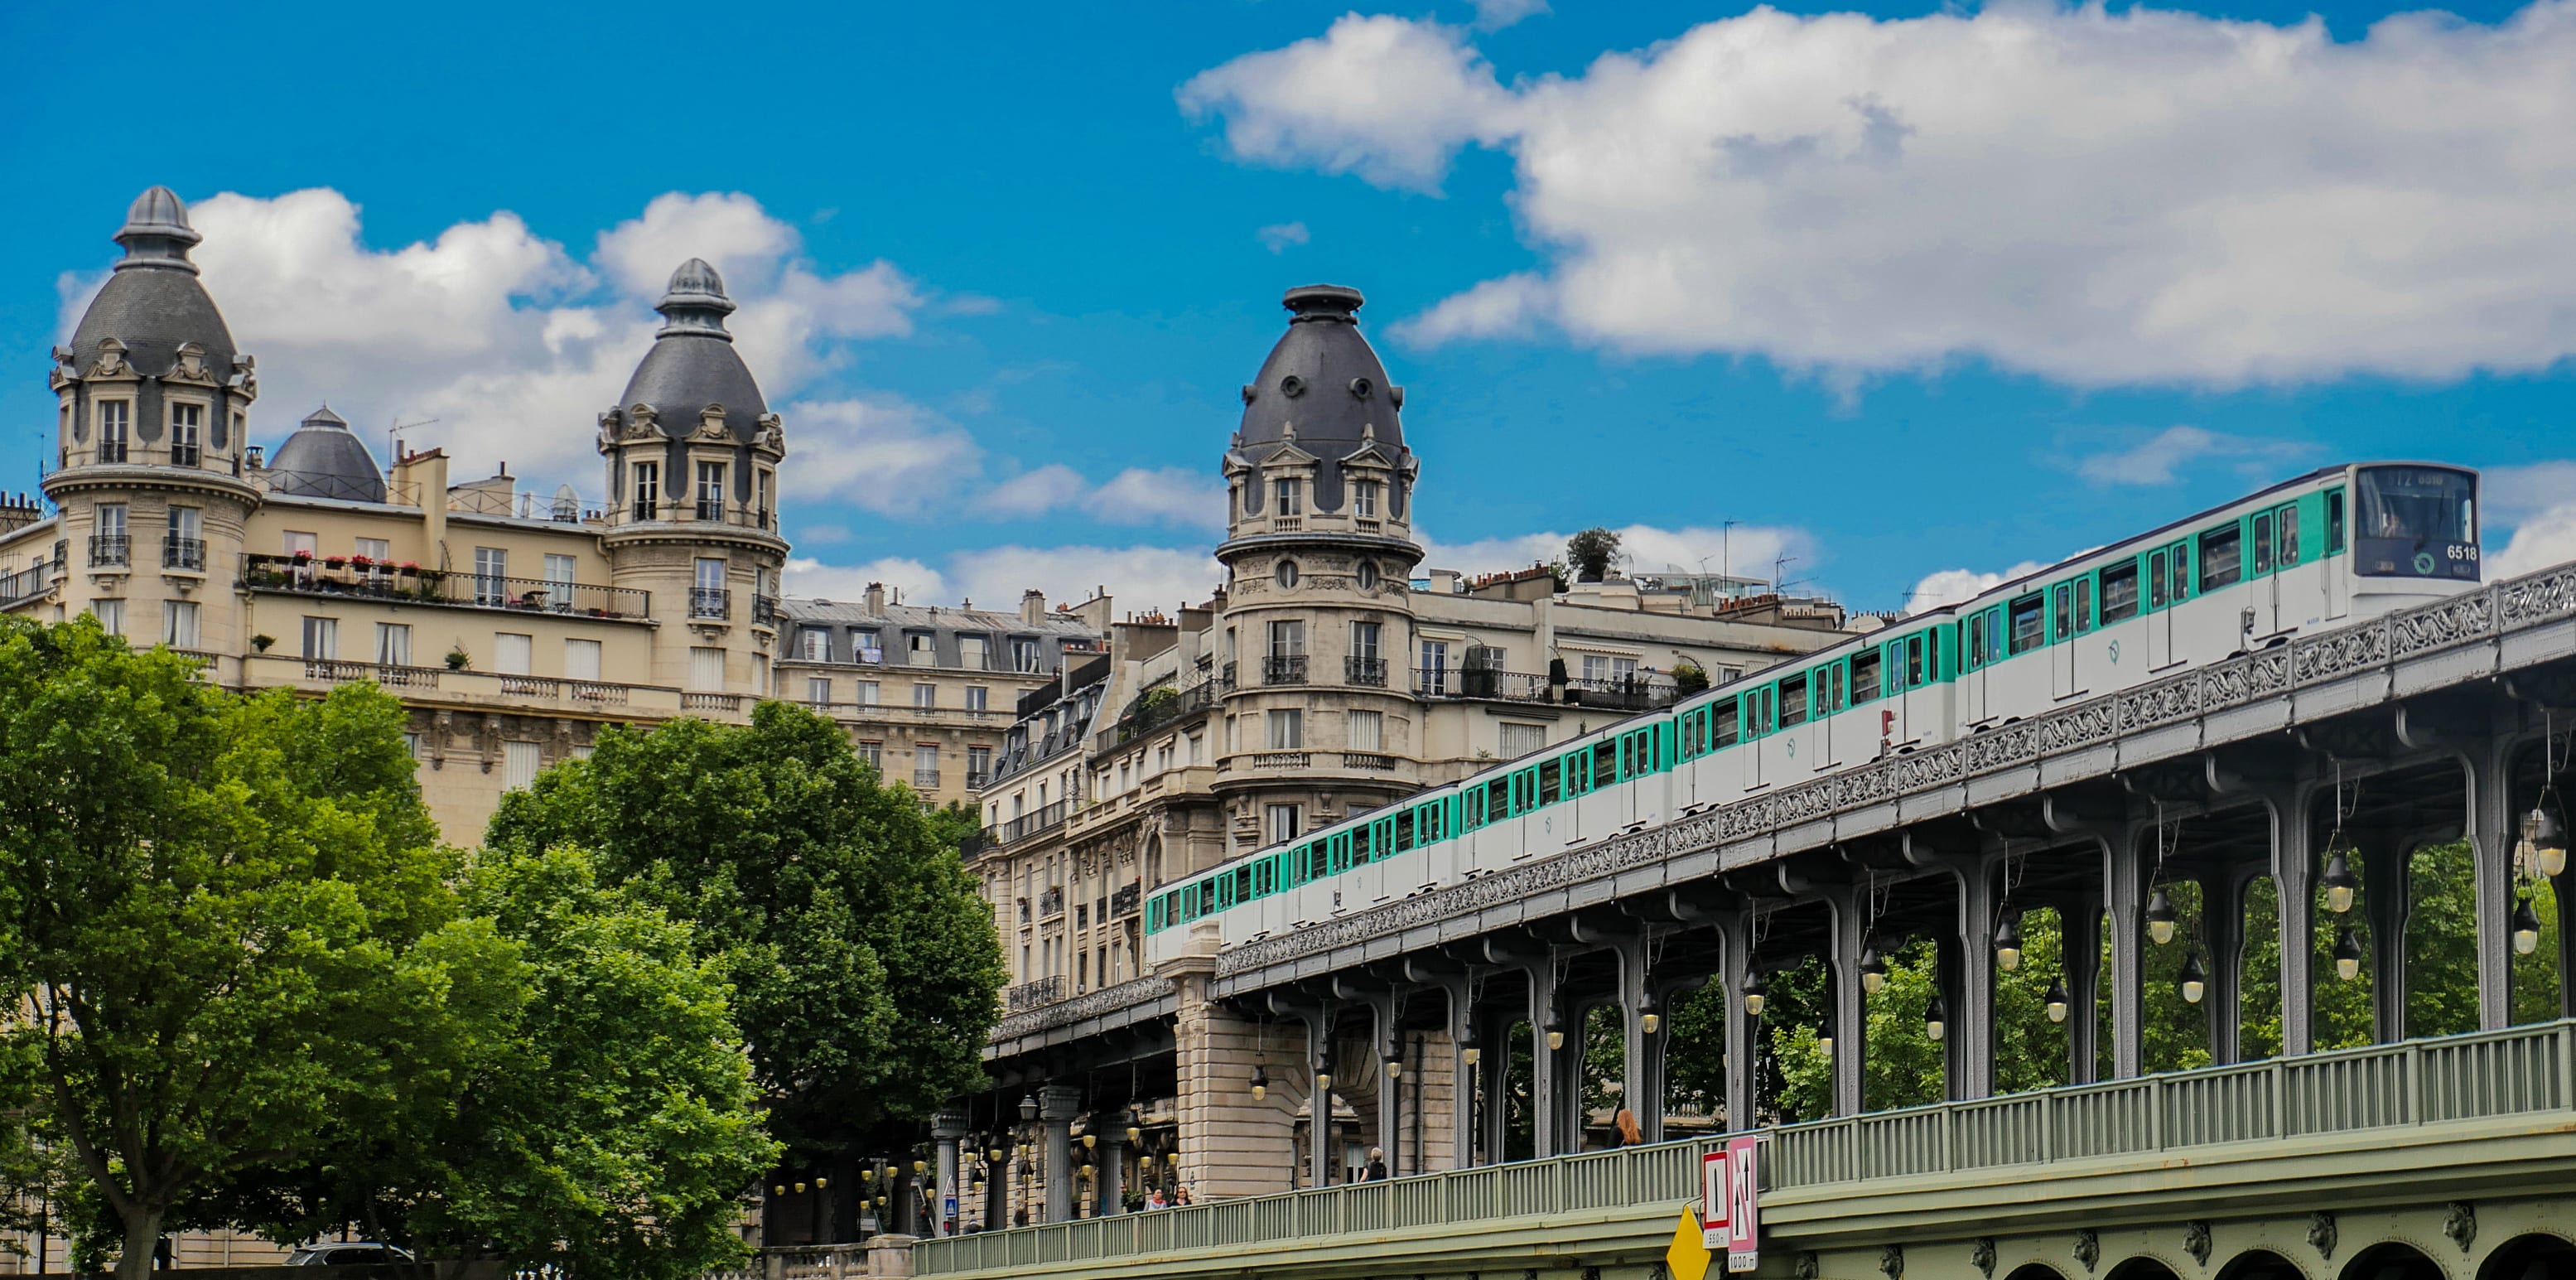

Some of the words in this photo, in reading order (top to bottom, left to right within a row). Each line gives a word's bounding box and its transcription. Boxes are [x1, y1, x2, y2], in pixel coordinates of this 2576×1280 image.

[2448, 544, 2477, 561] 6518
[1730, 1255, 1747, 1268] 1000
[1749, 1258, 1755, 1268] m
